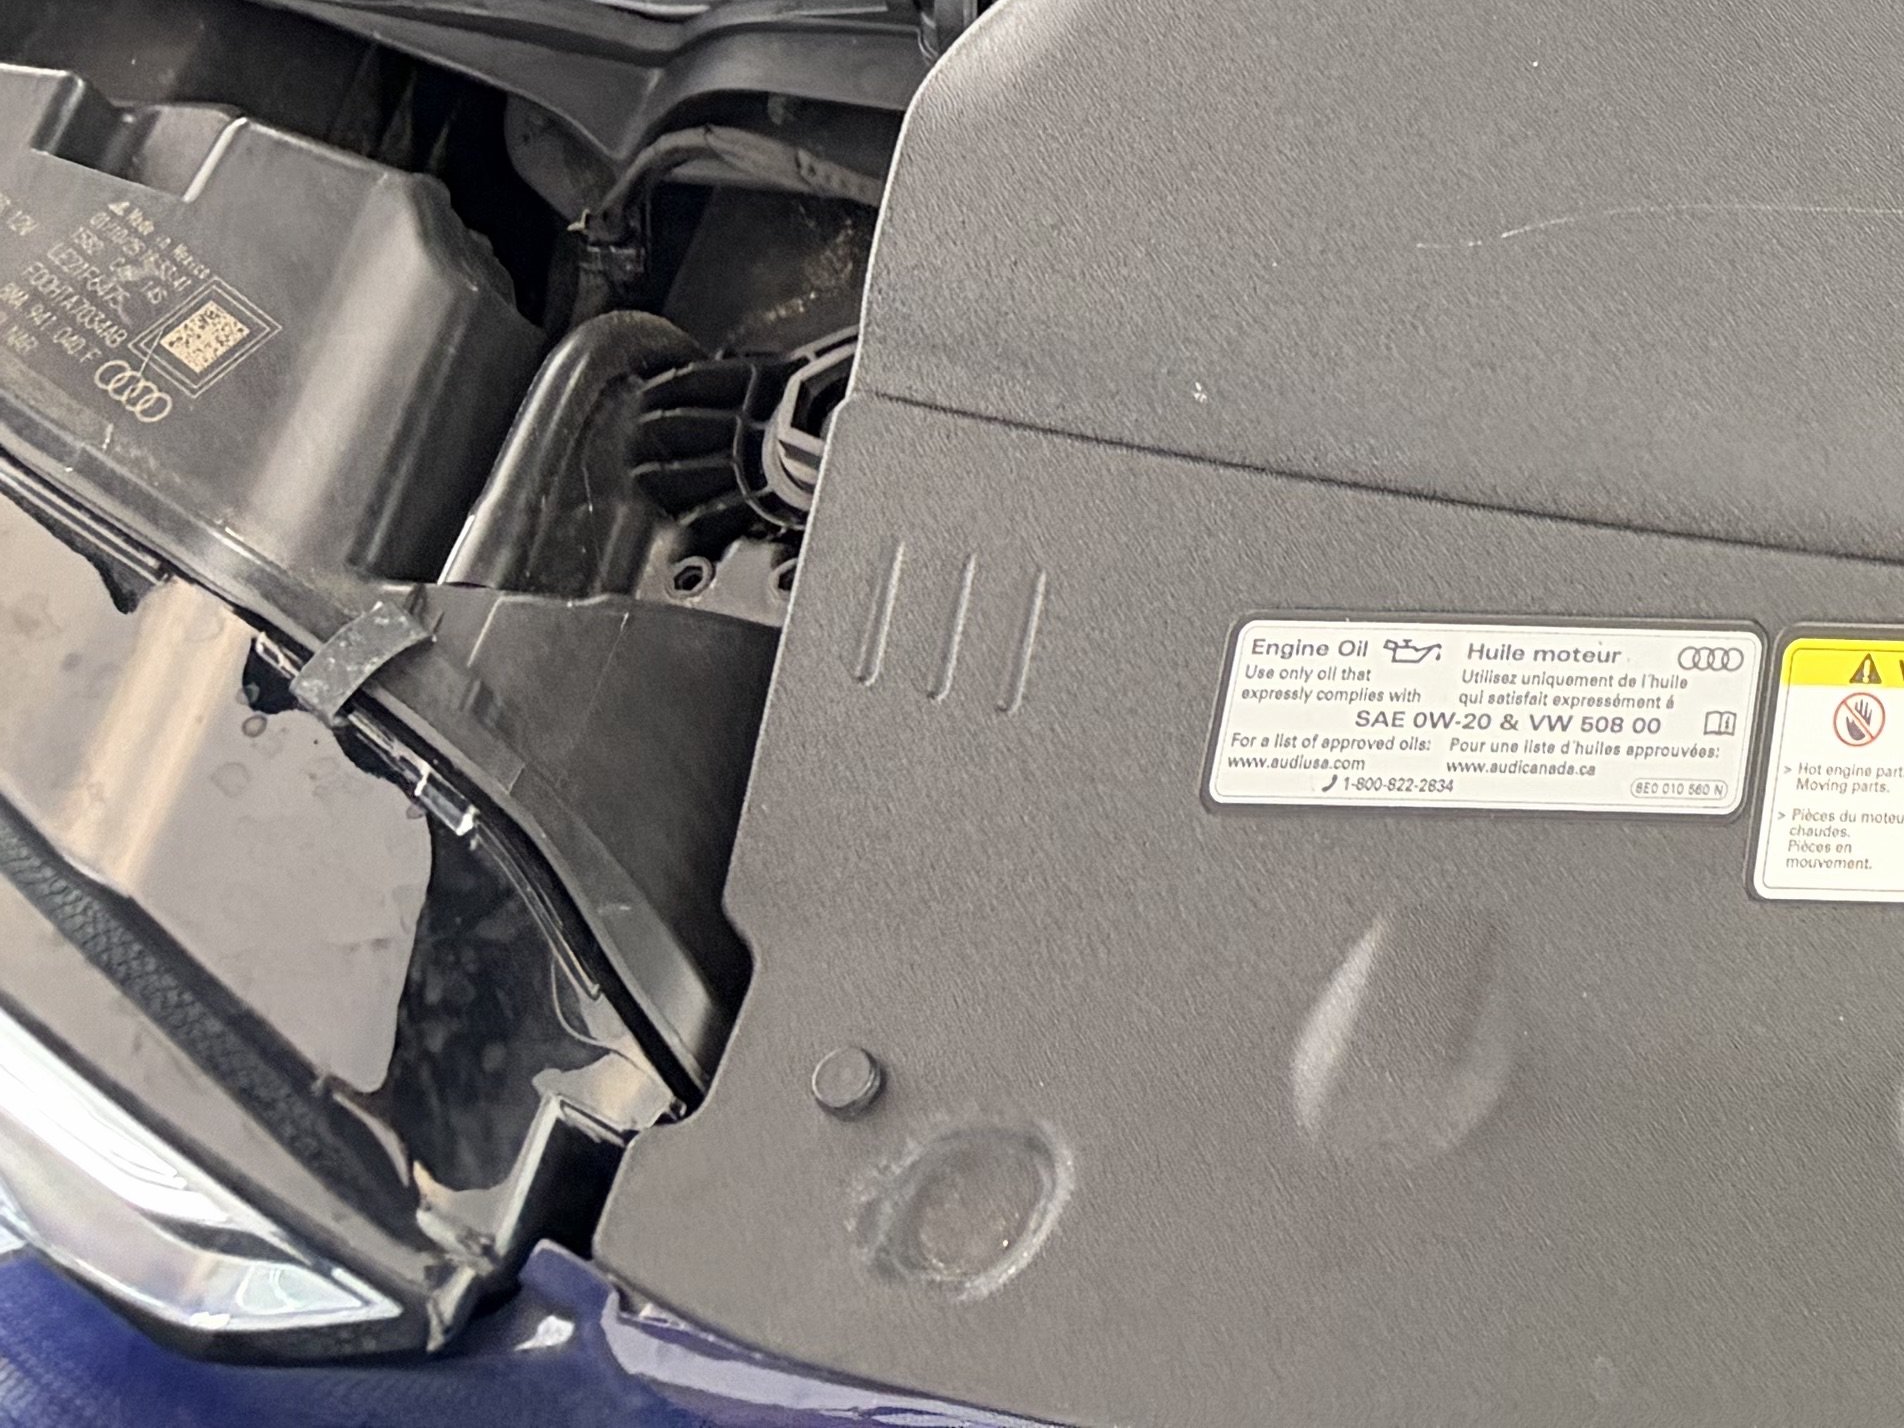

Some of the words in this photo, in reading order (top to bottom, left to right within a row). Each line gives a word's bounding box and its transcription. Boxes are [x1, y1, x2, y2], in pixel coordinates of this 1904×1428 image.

[1252, 639, 1329, 659] Engine
[1338, 640, 1368, 657] Oil
[1468, 643, 1525, 661] Huile
[1534, 648, 1621, 663] moteur
[1245, 664, 1274, 679] Use
[1279, 666, 1313, 683] only
[1317, 666, 1337, 680] oil
[1342, 667, 1371, 681] that
[1462, 669, 1517, 684] Utilisez
[1522, 671, 1613, 688] uniquement
[1618, 673, 1636, 688] de
[1242, 687, 1312, 704] expressly
[1317, 688, 1384, 704] complies
[1389, 688, 1421, 702] with
[1459, 690, 1483, 707] qui
[1488, 691, 1548, 706] satisfait
[1355, 710, 1405, 727] SAE
[1413, 712, 1491, 729] 0W-20
[1500, 714, 1518, 730] &
[1530, 714, 1573, 732] VW
[1581, 716, 1624, 733] 508
[1632, 718, 1661, 734] 00
[1231, 733, 1256, 747] For
[1261, 737, 1269, 747] a
[1274, 734, 1297, 748] list
[1302, 734, 1318, 748] of
[1321, 736, 1395, 752] approved
[1400, 736, 1430, 751] oils:
[1450, 738, 1486, 752] Pour
[1491, 742, 1518, 753] une
[1524, 740, 1555, 754] liste
[1228, 755, 1365, 770] www.audiusa.com
[1447, 760, 1595, 776] www.audicanada.ca
[1799, 762, 1821, 775] Hot
[1826, 764, 1871, 778] engine
[1345, 777, 1453, 792] 1-800-822-2834
[1662, 783, 1684, 795] 010
[1714, 784, 1723, 796] N
[1796, 778, 1847, 794] Moving
[1852, 782, 1889, 794] parts.
[1792, 808, 1835, 822] Pièces
[1840, 810, 1856, 822] du
[1789, 824, 1850, 838] chaudes.
[1788, 839, 1831, 853] Pièces
[1836, 844, 1852, 853] en
[1786, 858, 1872, 869] mouvement.
